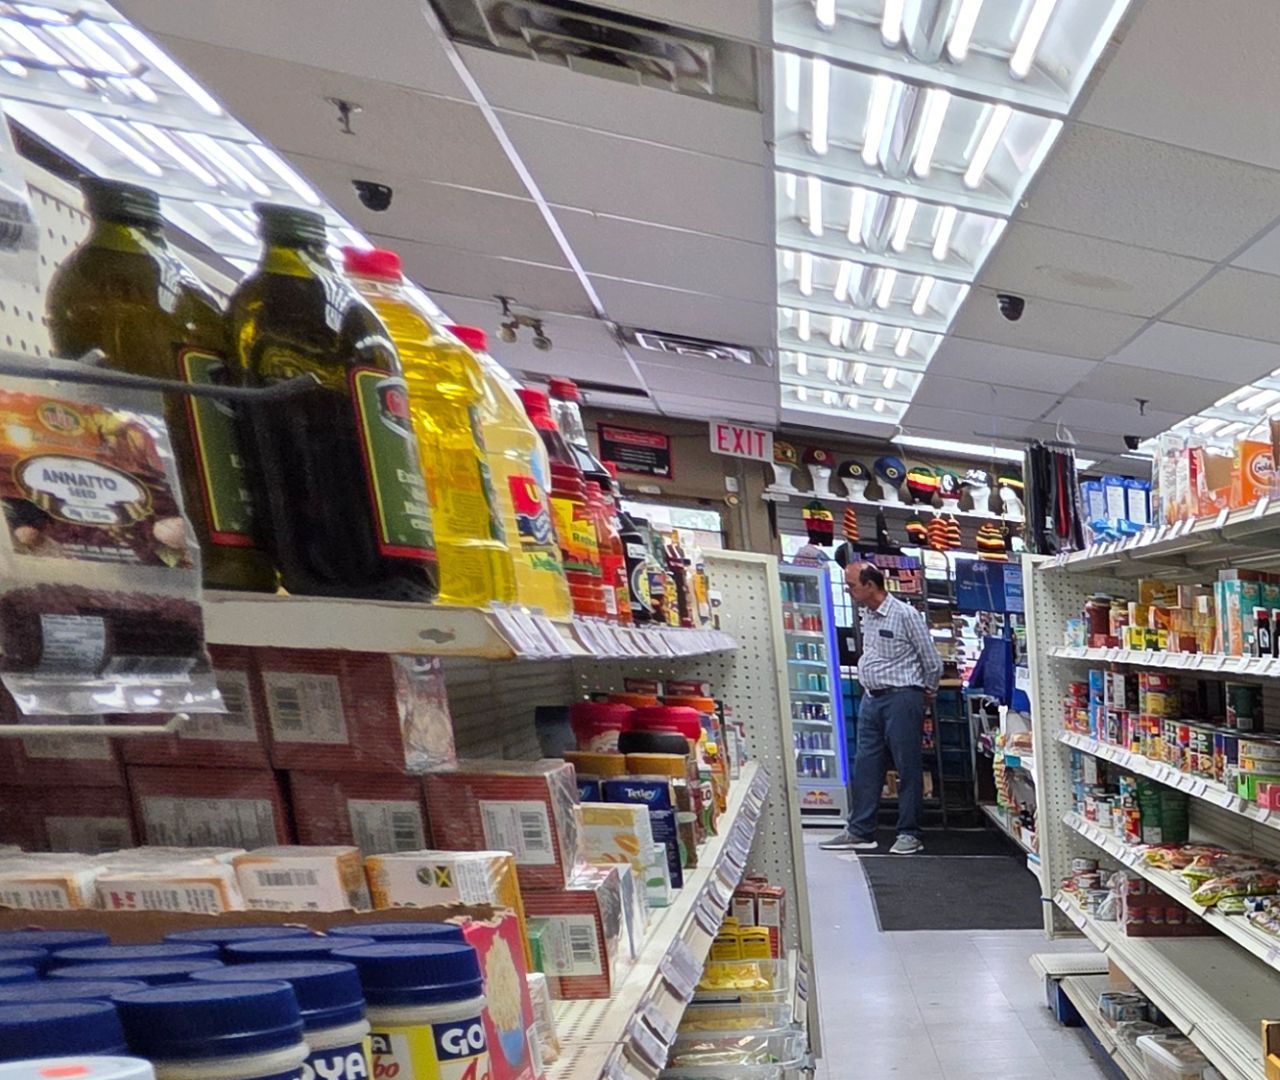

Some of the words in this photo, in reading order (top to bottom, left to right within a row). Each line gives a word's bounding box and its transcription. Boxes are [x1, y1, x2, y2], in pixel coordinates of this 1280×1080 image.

[716, 423, 766, 458] EXIT
[42, 468, 118, 491] ANNATTO
[68, 486, 97, 500] SEED
[624, 786, 657, 802] Tetley
[441, 1024, 485, 1055] GO
